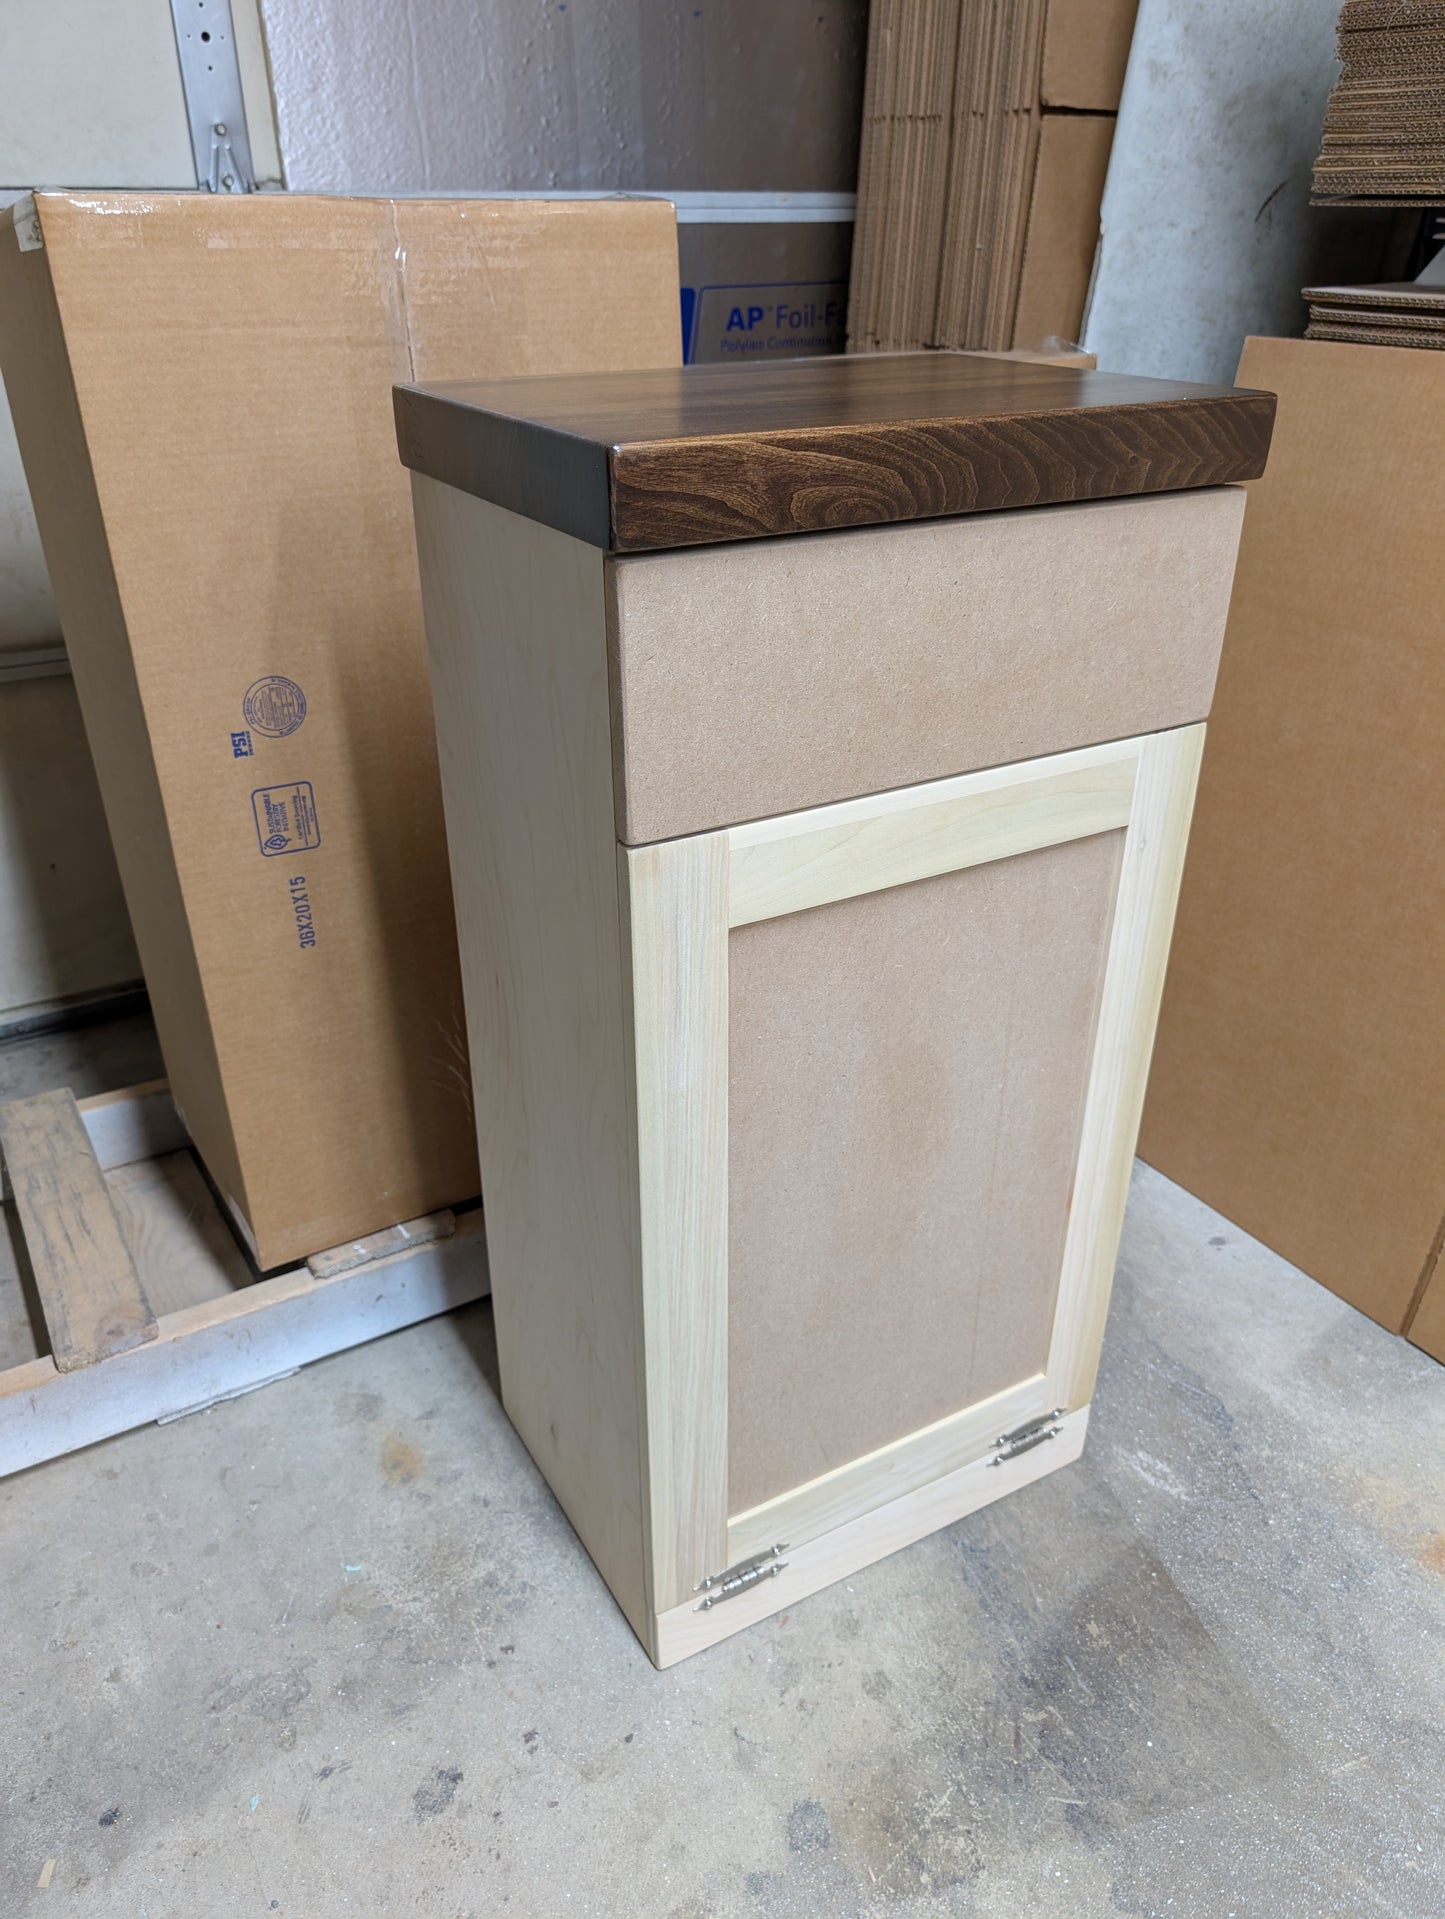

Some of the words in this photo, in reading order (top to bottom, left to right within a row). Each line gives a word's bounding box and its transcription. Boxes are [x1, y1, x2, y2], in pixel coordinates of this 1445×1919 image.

[720, 337, 765, 354] Polyiso
[230, 731, 249, 759] PSI
[263, 794, 275, 834] SUSTAINABLE
[272, 804, 282, 833] FORESTRY
[279, 802, 289, 832] INITIATIVE
[289, 876, 316, 949] 36X20X15
